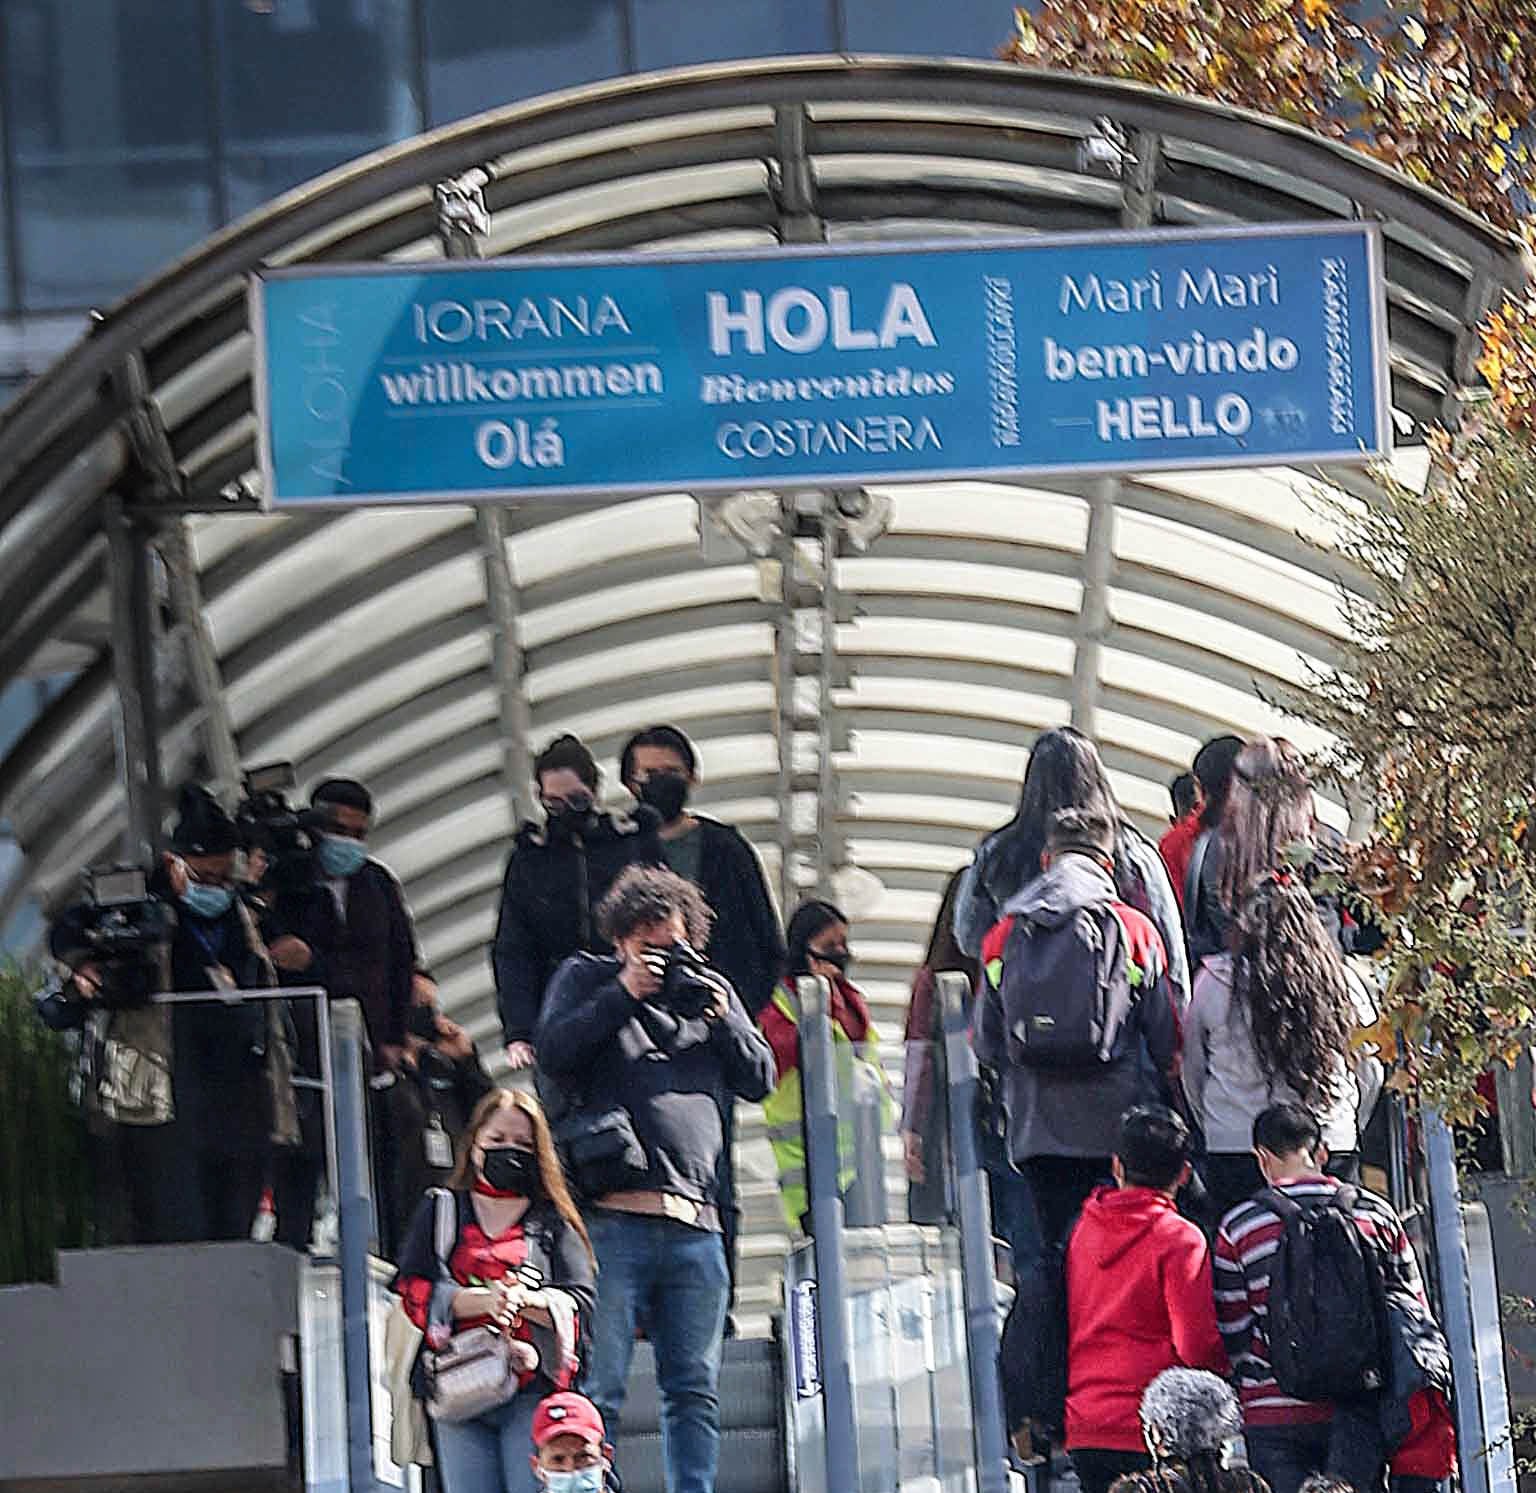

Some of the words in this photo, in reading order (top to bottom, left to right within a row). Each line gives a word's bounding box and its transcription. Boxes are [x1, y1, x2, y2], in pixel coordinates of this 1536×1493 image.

[1059, 270, 1163, 315] Mari
[1175, 263, 1280, 309] Mari
[413, 294, 633, 345] IORANA
[706, 281, 939, 357] HOLA
[1044, 327, 1300, 382] bem-vindo
[298, 303, 352, 486] ALOHA
[382, 362, 664, 405] willkommen
[701, 366, 955, 404] Bienvenidos
[476, 416, 567, 470] Olá
[718, 415, 943, 459] COSTANERA
[1096, 393, 1252, 442] HELLO
